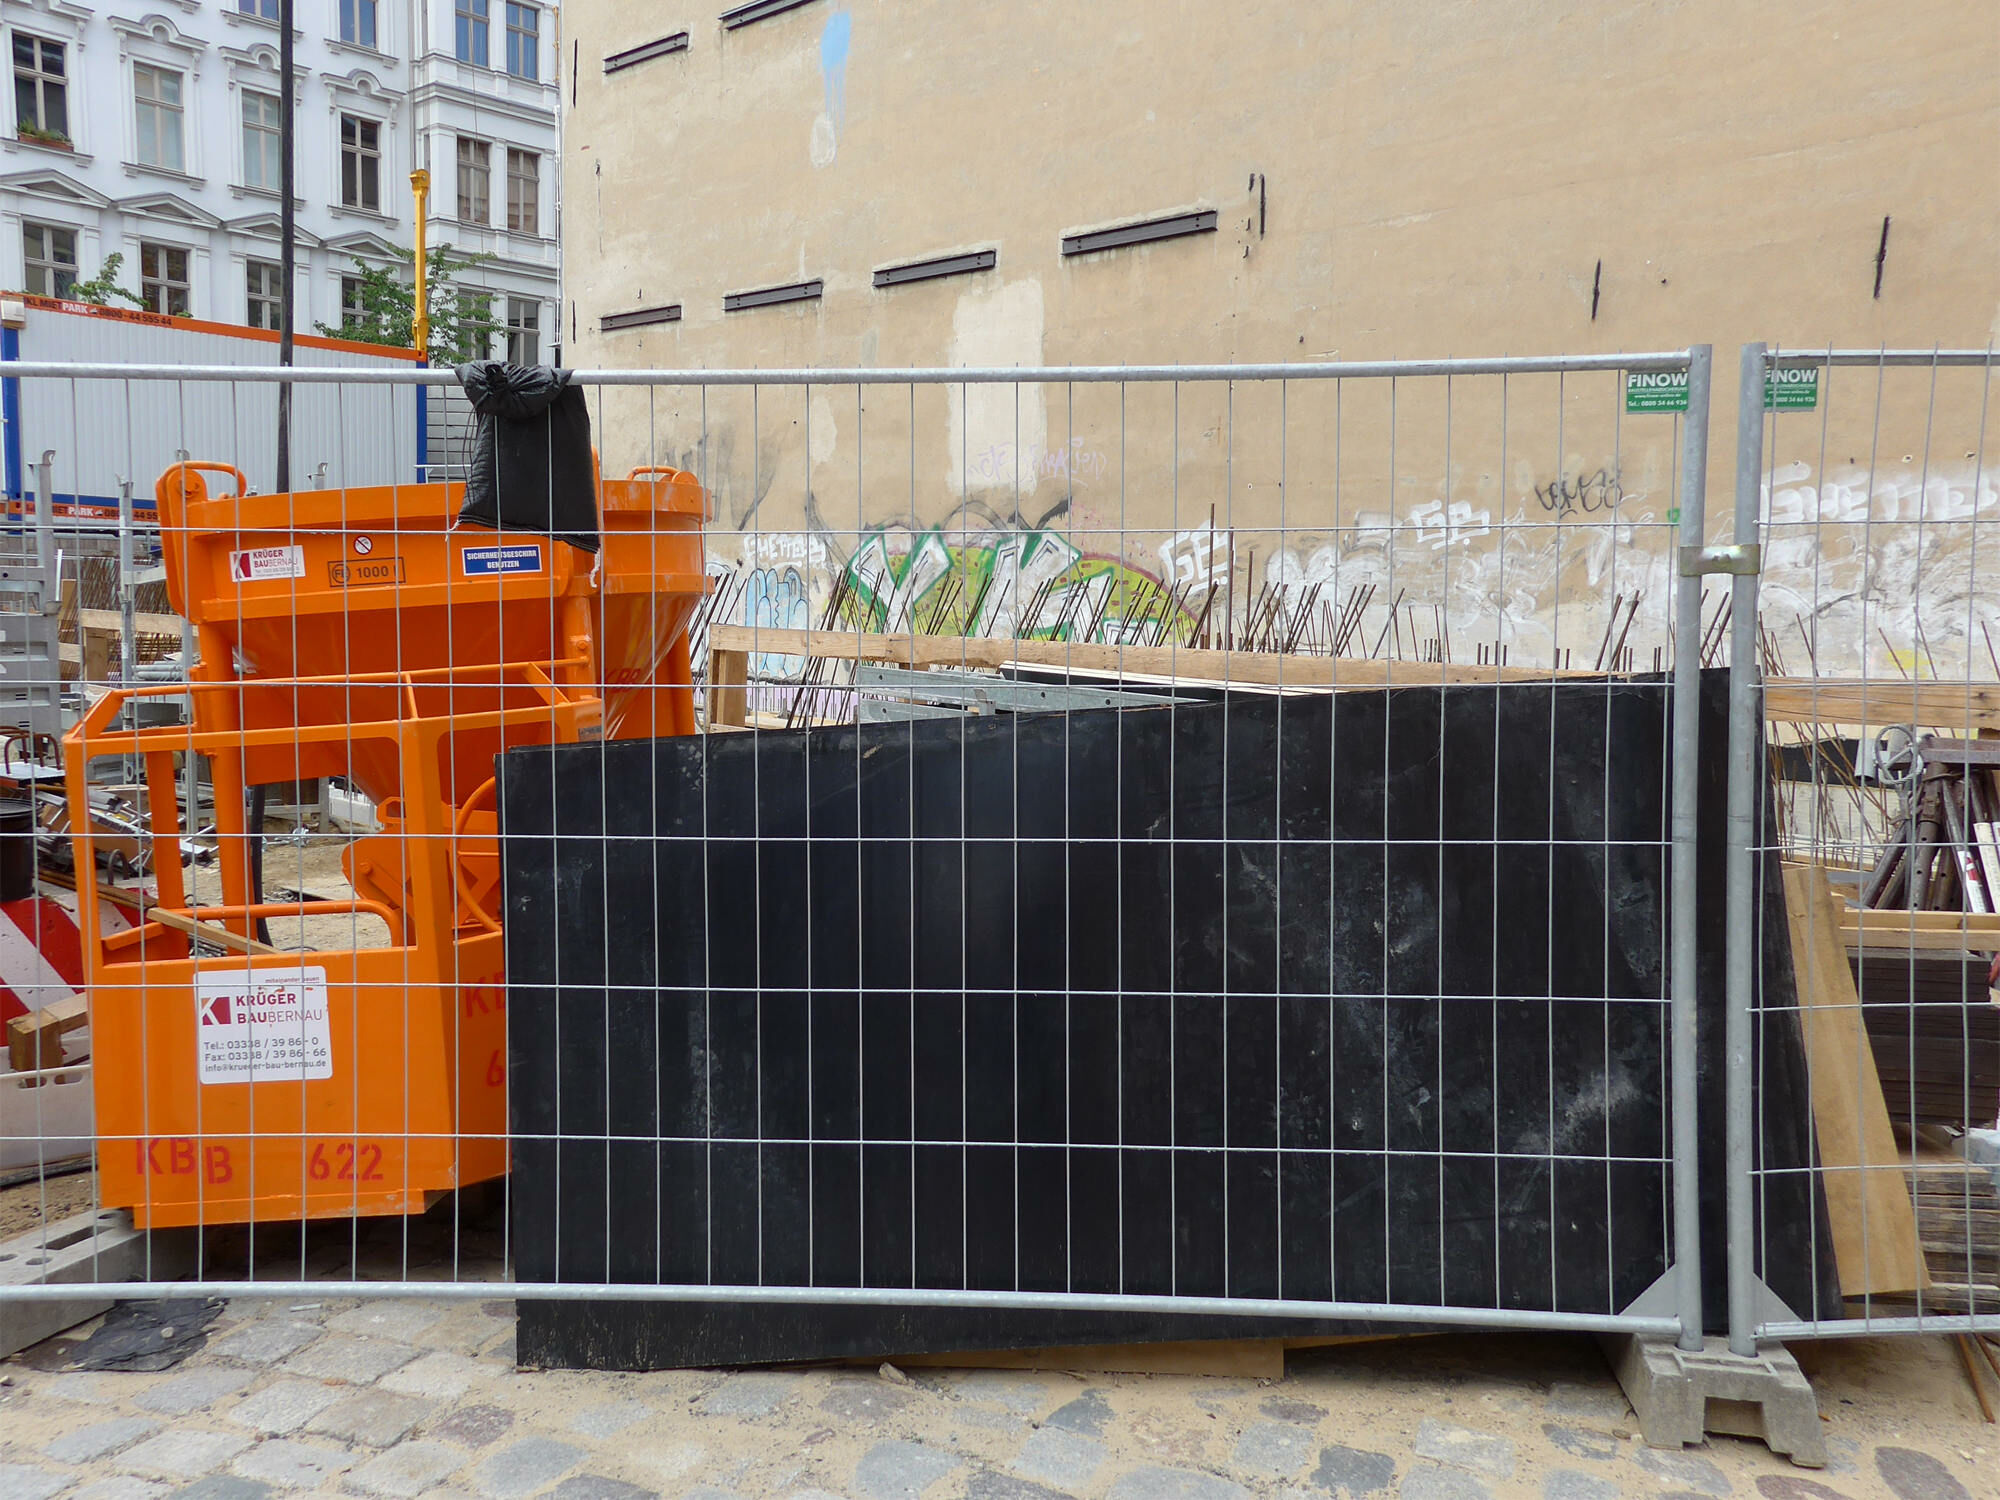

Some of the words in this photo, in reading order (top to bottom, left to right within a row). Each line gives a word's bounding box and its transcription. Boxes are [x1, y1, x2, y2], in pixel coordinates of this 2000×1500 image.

[1628, 373, 1688, 387] FINOW
[253, 548, 284, 559] KRÜGER
[356, 565, 389, 578] 1000
[236, 991, 296, 1007] KRÜGER
[203, 1041, 225, 1050] Tel.:
[227, 1039, 261, 1049] 03338
[272, 1038, 285, 1047] 39
[288, 1037, 302, 1046] 86
[311, 1036, 319, 1046] 0
[205, 1052, 225, 1061] Fax:
[273, 1049, 286, 1059] 39
[289, 1048, 303, 1058] 86
[313, 1047, 327, 1057] 66
[136, 1135, 233, 1185] KBB
[308, 1142, 384, 1182] 622
